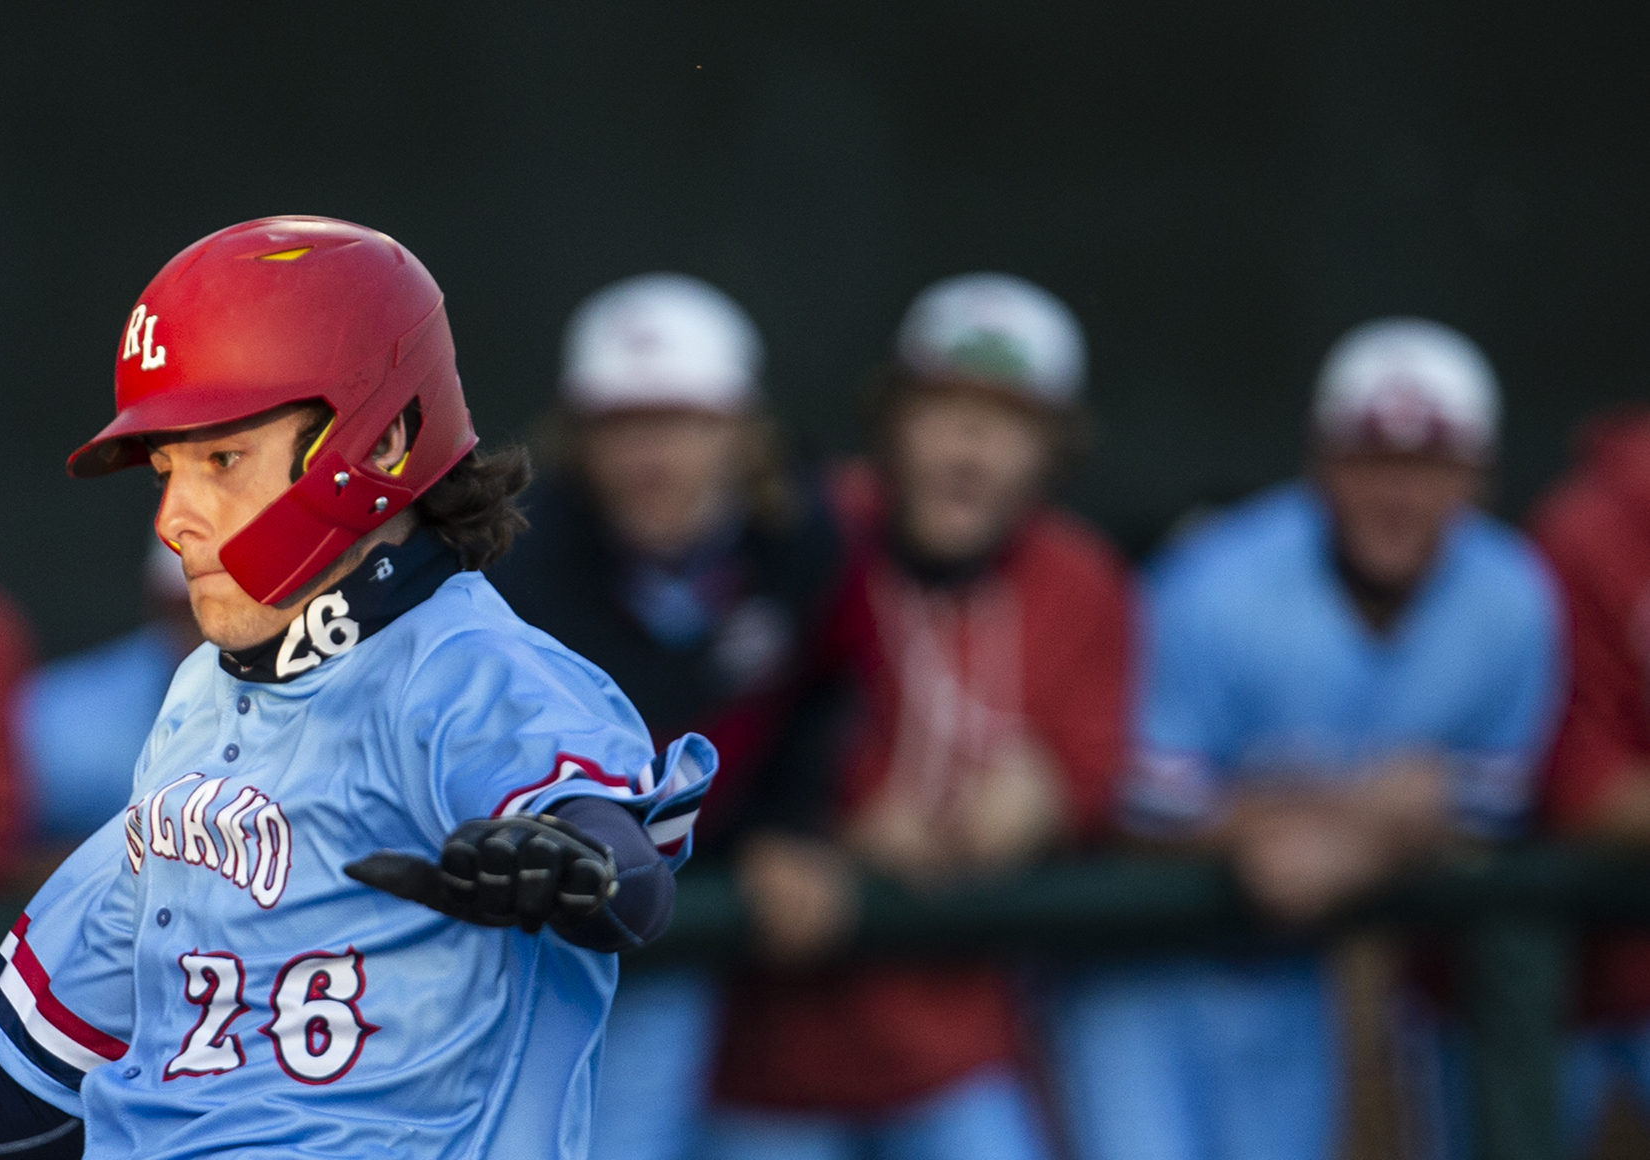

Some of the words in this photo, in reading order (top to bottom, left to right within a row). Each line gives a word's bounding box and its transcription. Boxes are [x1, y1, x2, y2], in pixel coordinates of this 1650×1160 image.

[123, 303, 167, 371] RL
[275, 589, 360, 679] 26
[163, 945, 381, 1085] 26
